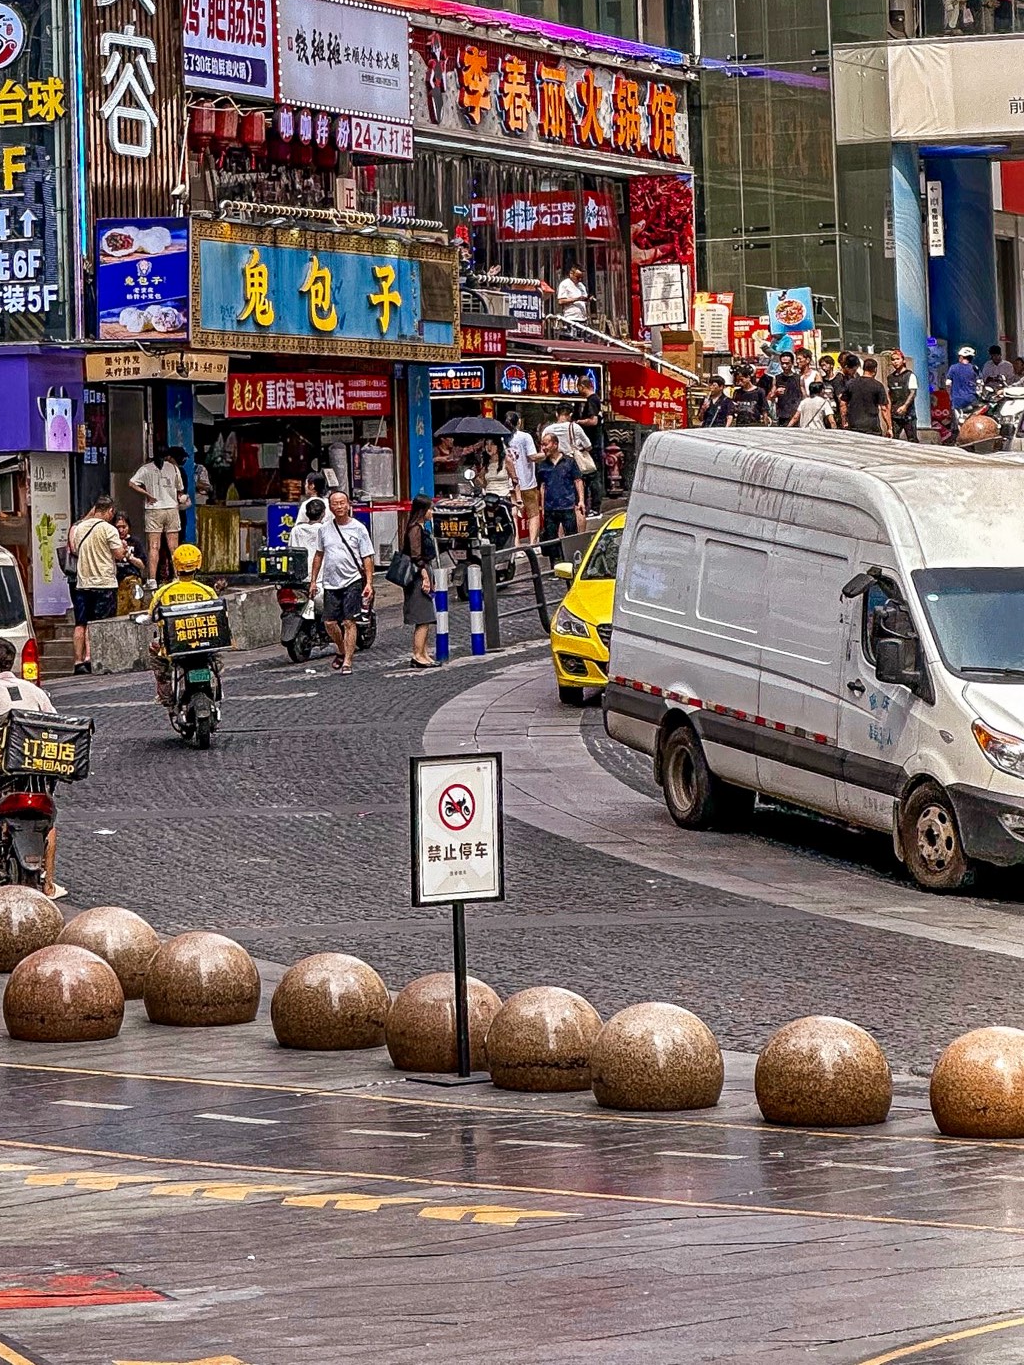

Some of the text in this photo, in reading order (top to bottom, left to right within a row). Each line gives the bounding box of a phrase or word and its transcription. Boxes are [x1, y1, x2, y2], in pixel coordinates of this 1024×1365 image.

[355, 122, 412, 154] 24 不打烊
[235, 248, 403, 334] 鬼包子
[265, 379, 346, 411] 重庆第二家实体店
[23, 738, 76, 762] 订酒店
[427, 840, 489, 863] 禁止停车
